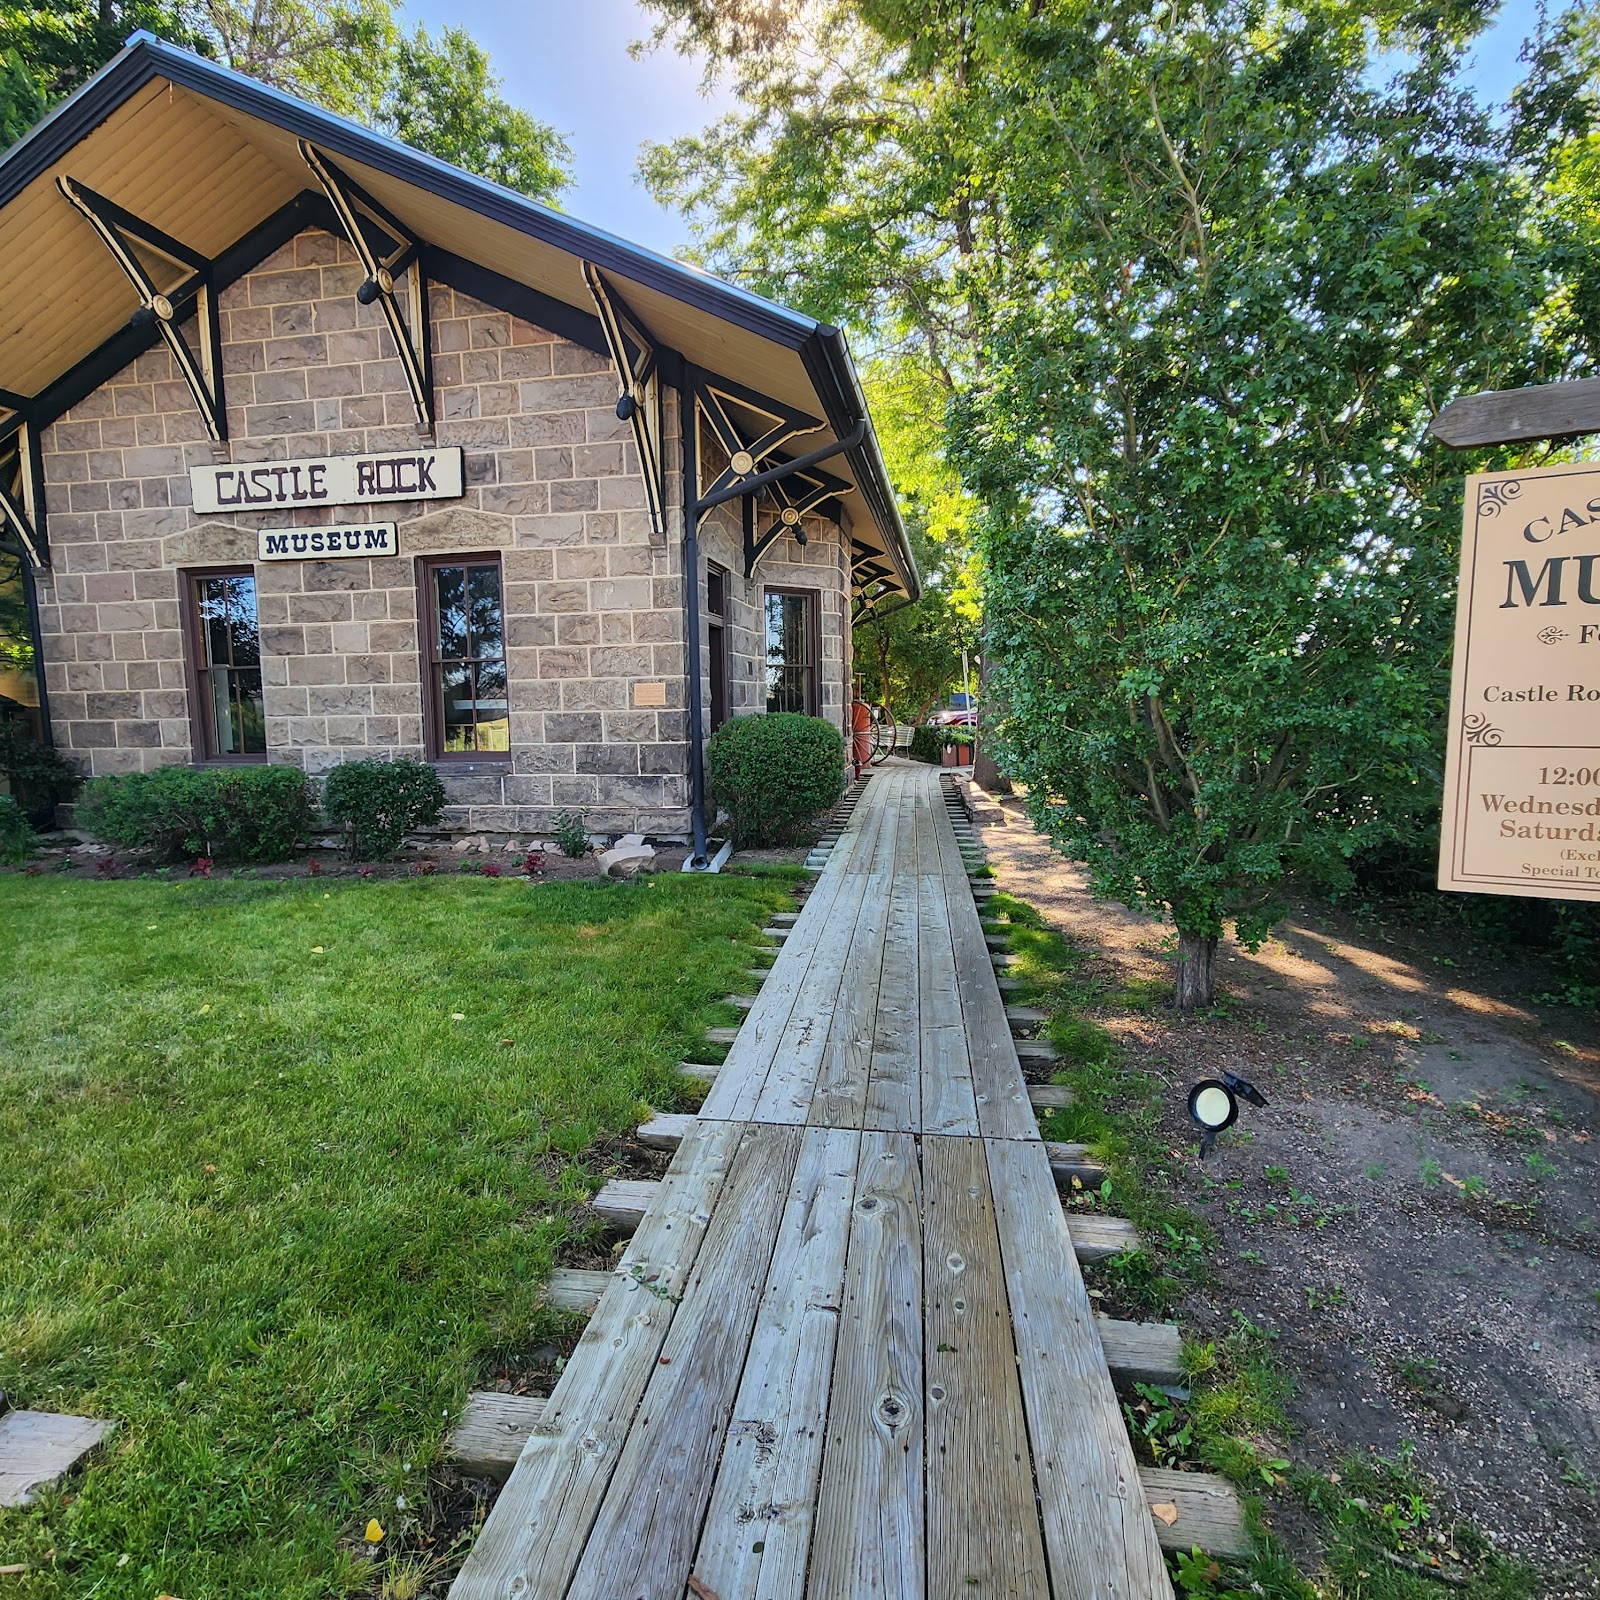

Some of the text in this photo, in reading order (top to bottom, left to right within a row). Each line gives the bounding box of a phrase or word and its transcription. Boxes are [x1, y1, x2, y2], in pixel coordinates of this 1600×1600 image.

[215, 456, 437, 505] CASTLE ROCK
[266, 529, 388, 554] MUSEUM
[1578, 624, 1600, 644] F
[1483, 685, 1600, 703] Castle Ro
[1480, 794, 1600, 816] Wednesd
[1500, 819, 1600, 842] Saturd
[1521, 863, 1579, 877] Special
